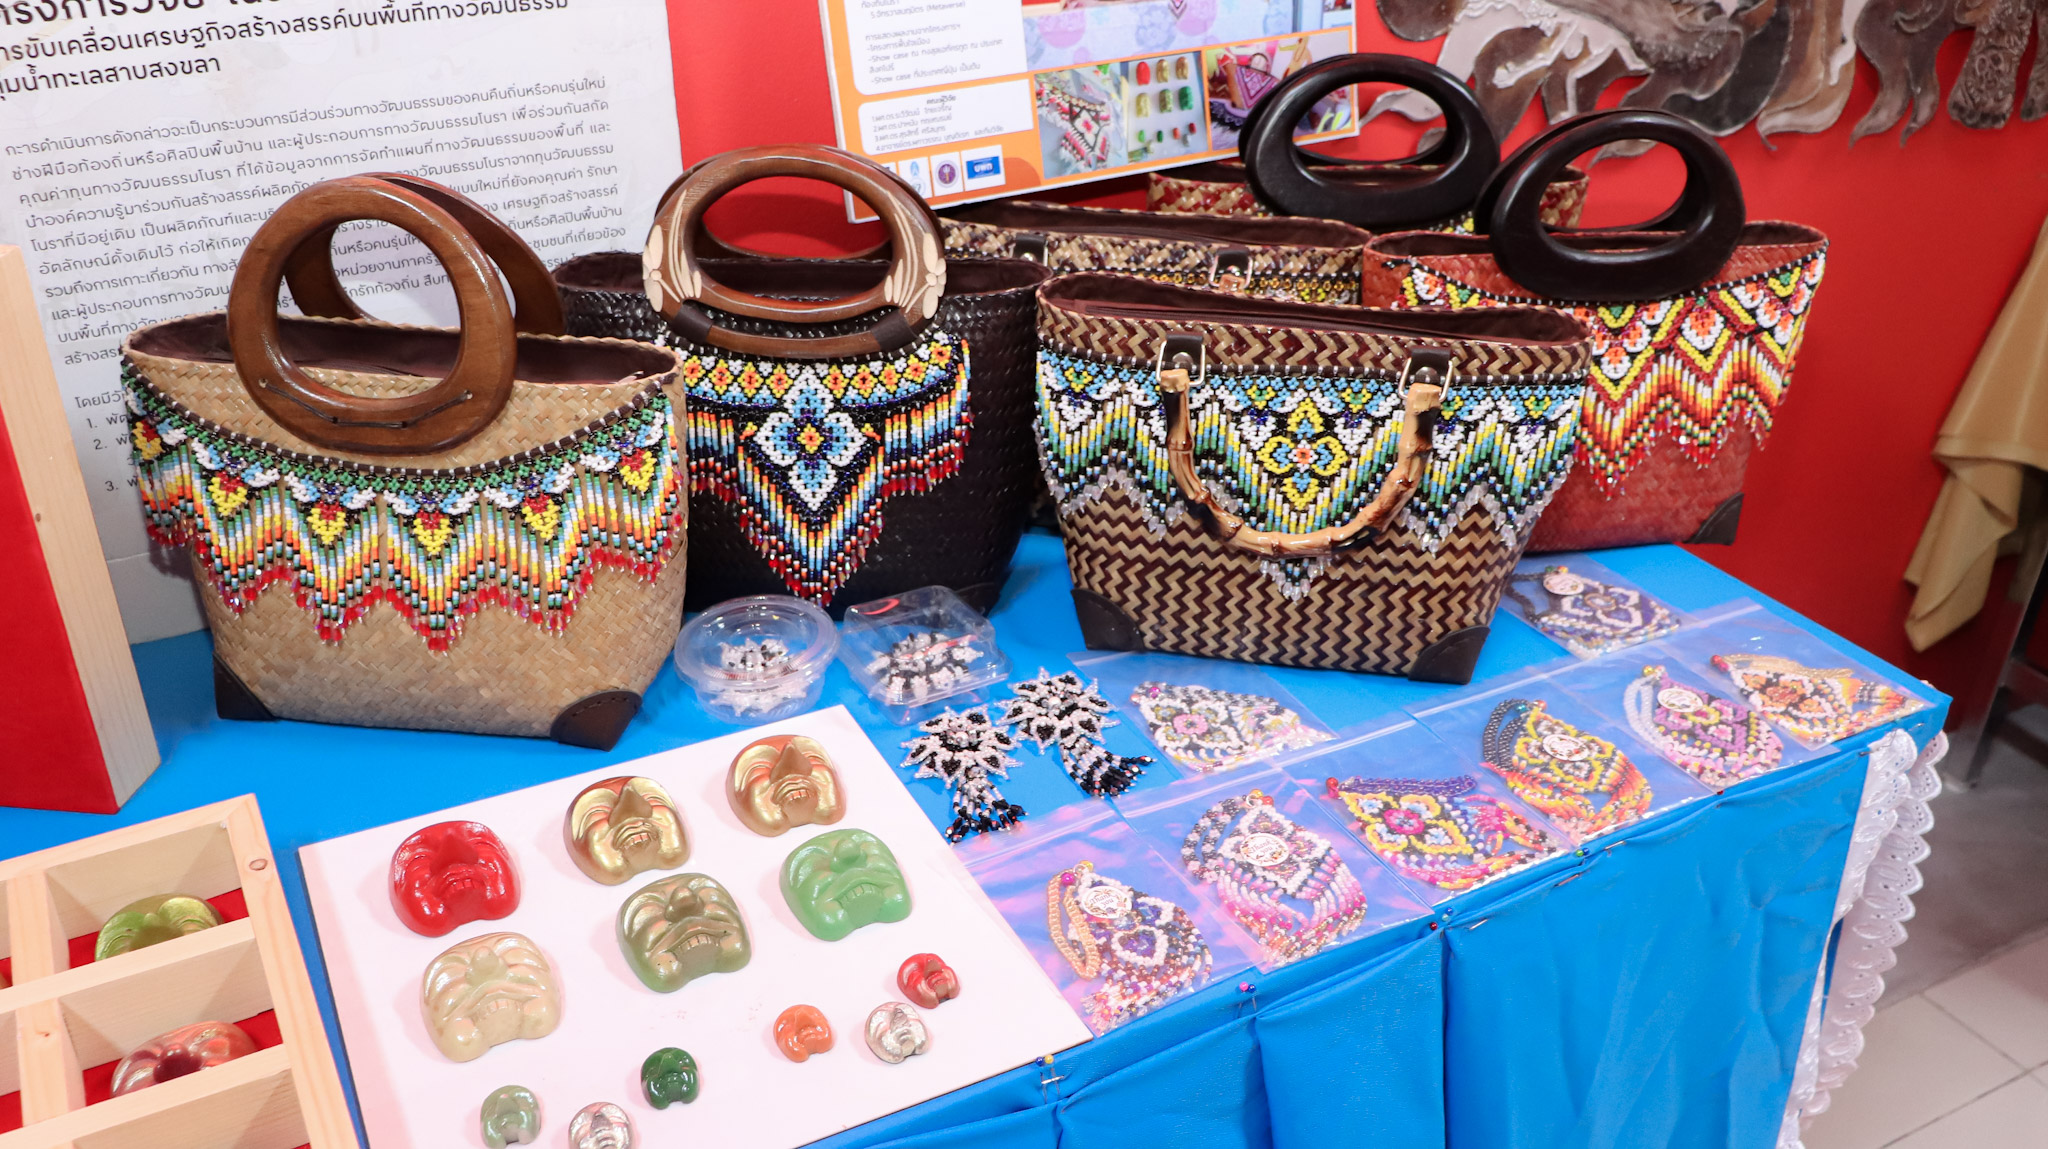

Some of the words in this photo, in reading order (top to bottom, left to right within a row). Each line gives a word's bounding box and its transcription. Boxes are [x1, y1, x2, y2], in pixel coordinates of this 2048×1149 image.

[12, 140, 263, 181] ช่างฝีมือท้องถิ่นหรือศิลปินพื้นบ้าน
[268, 111, 508, 150] และผู้ประกอบการทางวัฒนธรรมโนรา
[511, 98, 610, 121] เพื่อร่วมกันสกัด
[19, 167, 232, 208] คุณค่าทุนทางวัฒนธรรมโนรา
[589, 122, 613, 135] และ
[30, 227, 136, 252] โนราที่มีอยู่เดิม
[449, 167, 584, 195] แบบใหม่ที่ยังคงคุณค่า
[587, 163, 619, 178] รักษา
[39, 244, 175, 275] อัตลักษณ์ดั้งเดิมไว้
[503, 182, 619, 211] เศรษฐกิจสร้างสรรค์
[45, 265, 200, 298] รวมถึงการเกาะเกี่ยวกัน
[86, 417, 98, 429] 1.
[93, 438, 108, 450] 2.
[104, 480, 119, 492] 3.
